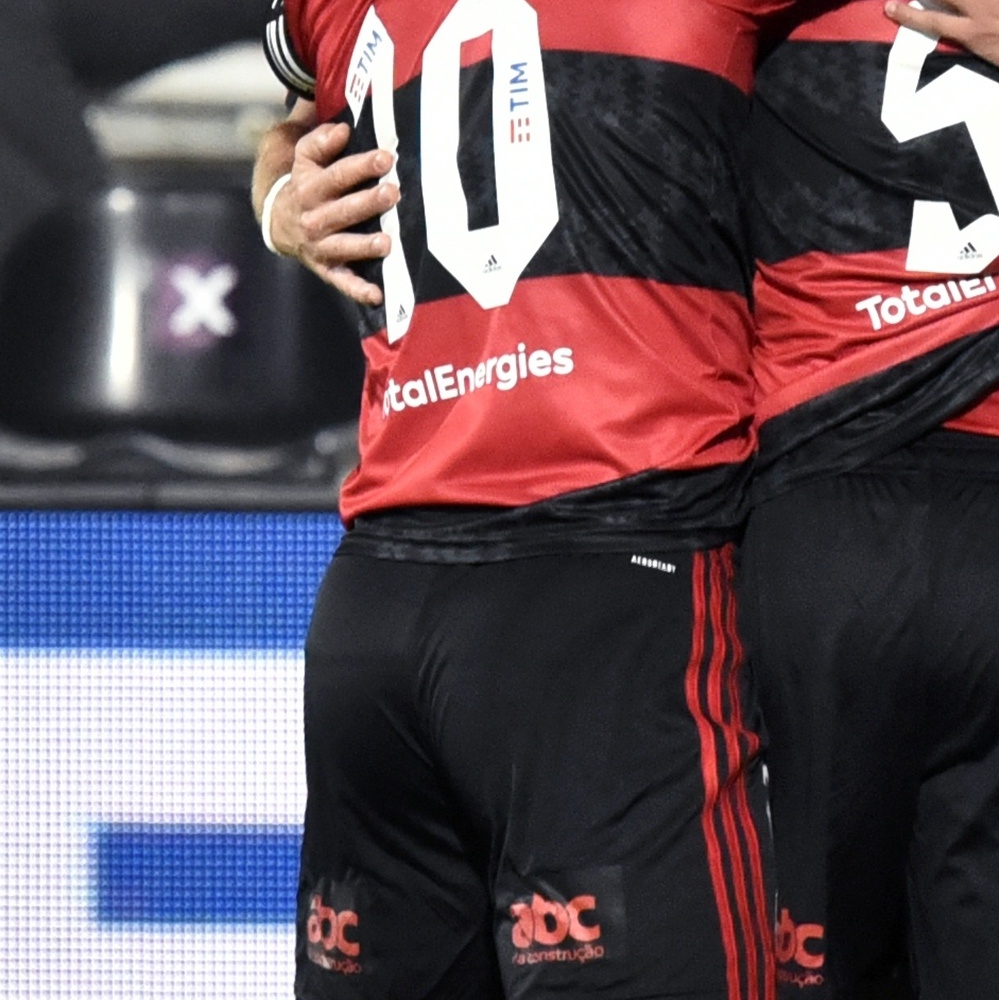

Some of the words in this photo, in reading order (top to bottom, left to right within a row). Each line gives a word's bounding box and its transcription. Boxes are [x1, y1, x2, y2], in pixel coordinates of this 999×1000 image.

[356, 29, 383, 74] TIM
[509, 61, 530, 113] TIM
[509, 892, 601, 949] abc
[774, 907, 825, 969] bc
